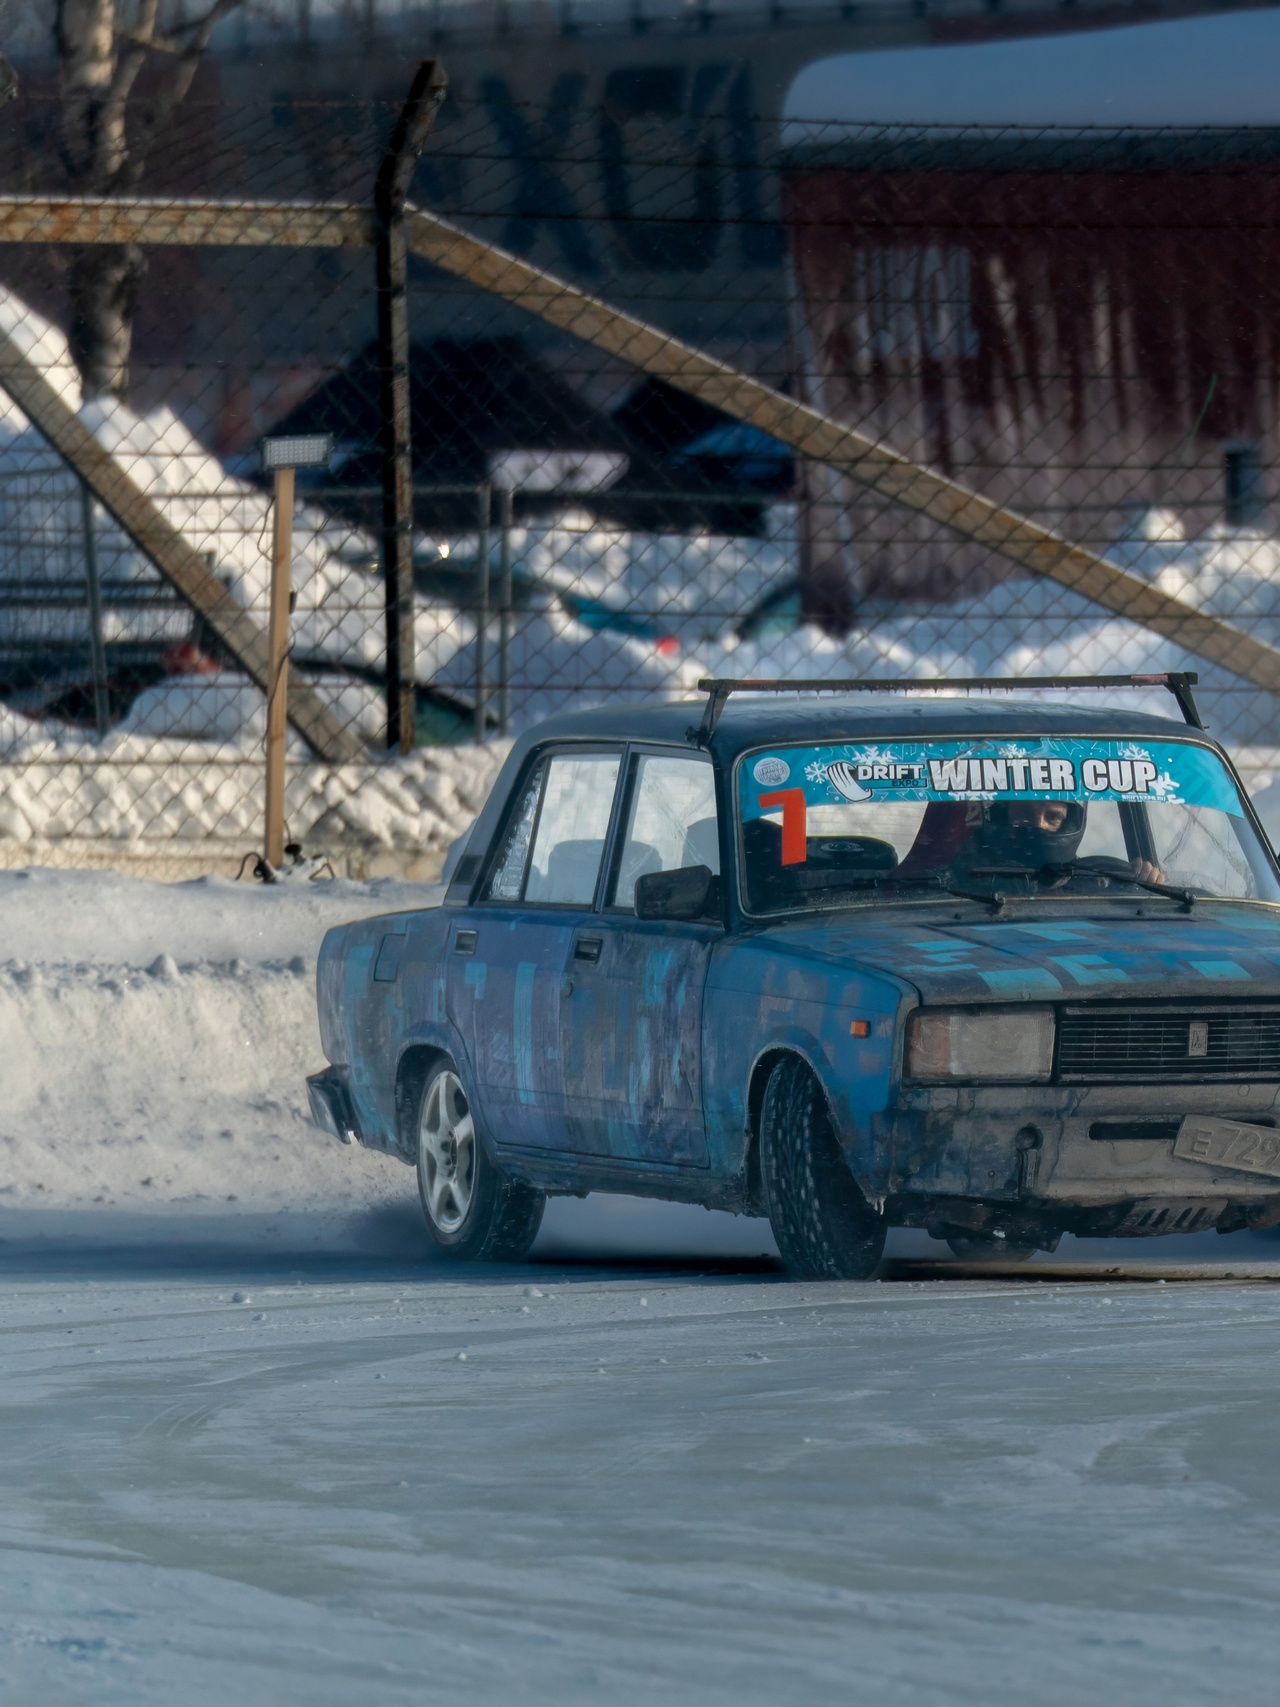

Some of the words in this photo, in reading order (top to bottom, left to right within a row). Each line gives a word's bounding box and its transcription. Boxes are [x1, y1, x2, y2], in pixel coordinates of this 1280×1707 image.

[857, 764, 924, 780] DRIFT
[927, 758, 1076, 792] WINTER
[1082, 759, 1159, 793] CUP
[892, 779, 919, 787] EXPO
